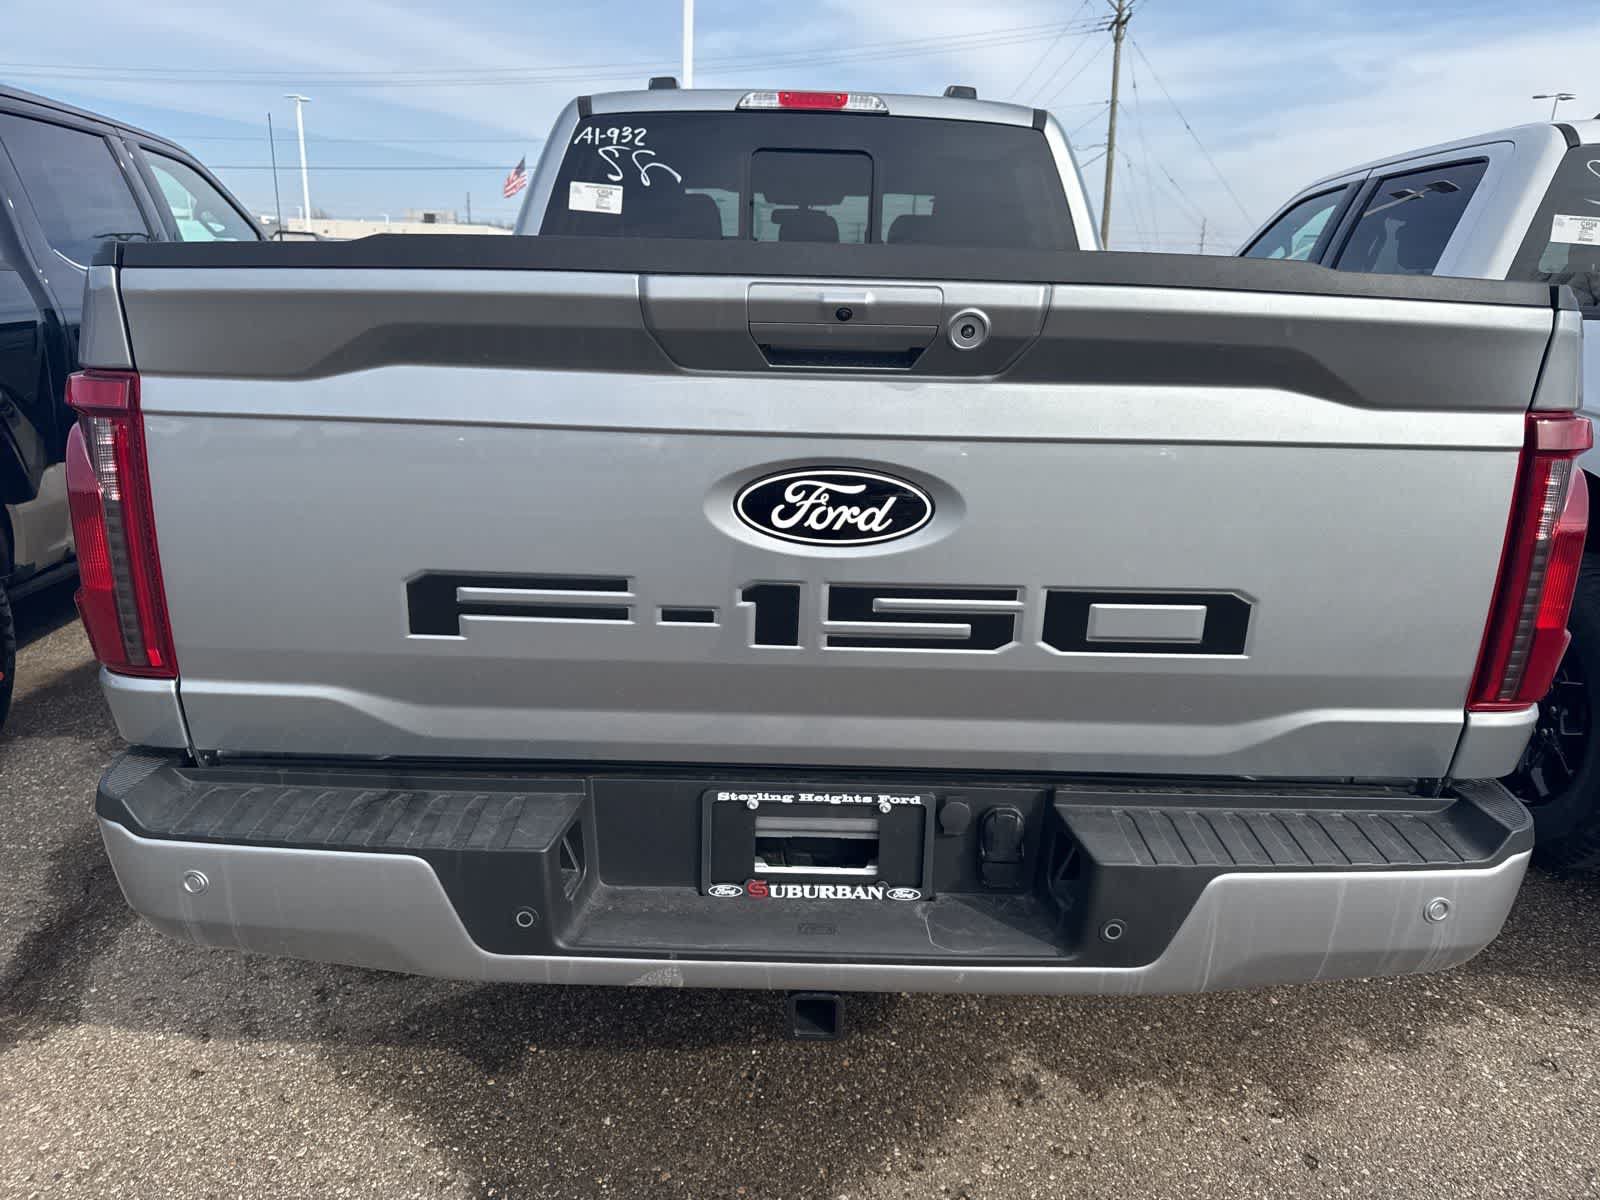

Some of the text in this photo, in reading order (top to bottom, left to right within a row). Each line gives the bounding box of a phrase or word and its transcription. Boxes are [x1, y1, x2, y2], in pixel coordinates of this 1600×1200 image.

[771, 480, 897, 532] Ford
[404, 570, 1254, 658] F-150
[717, 792, 921, 805] Sterling Heights Ford
[747, 880, 884, 900] SUBURBAN
